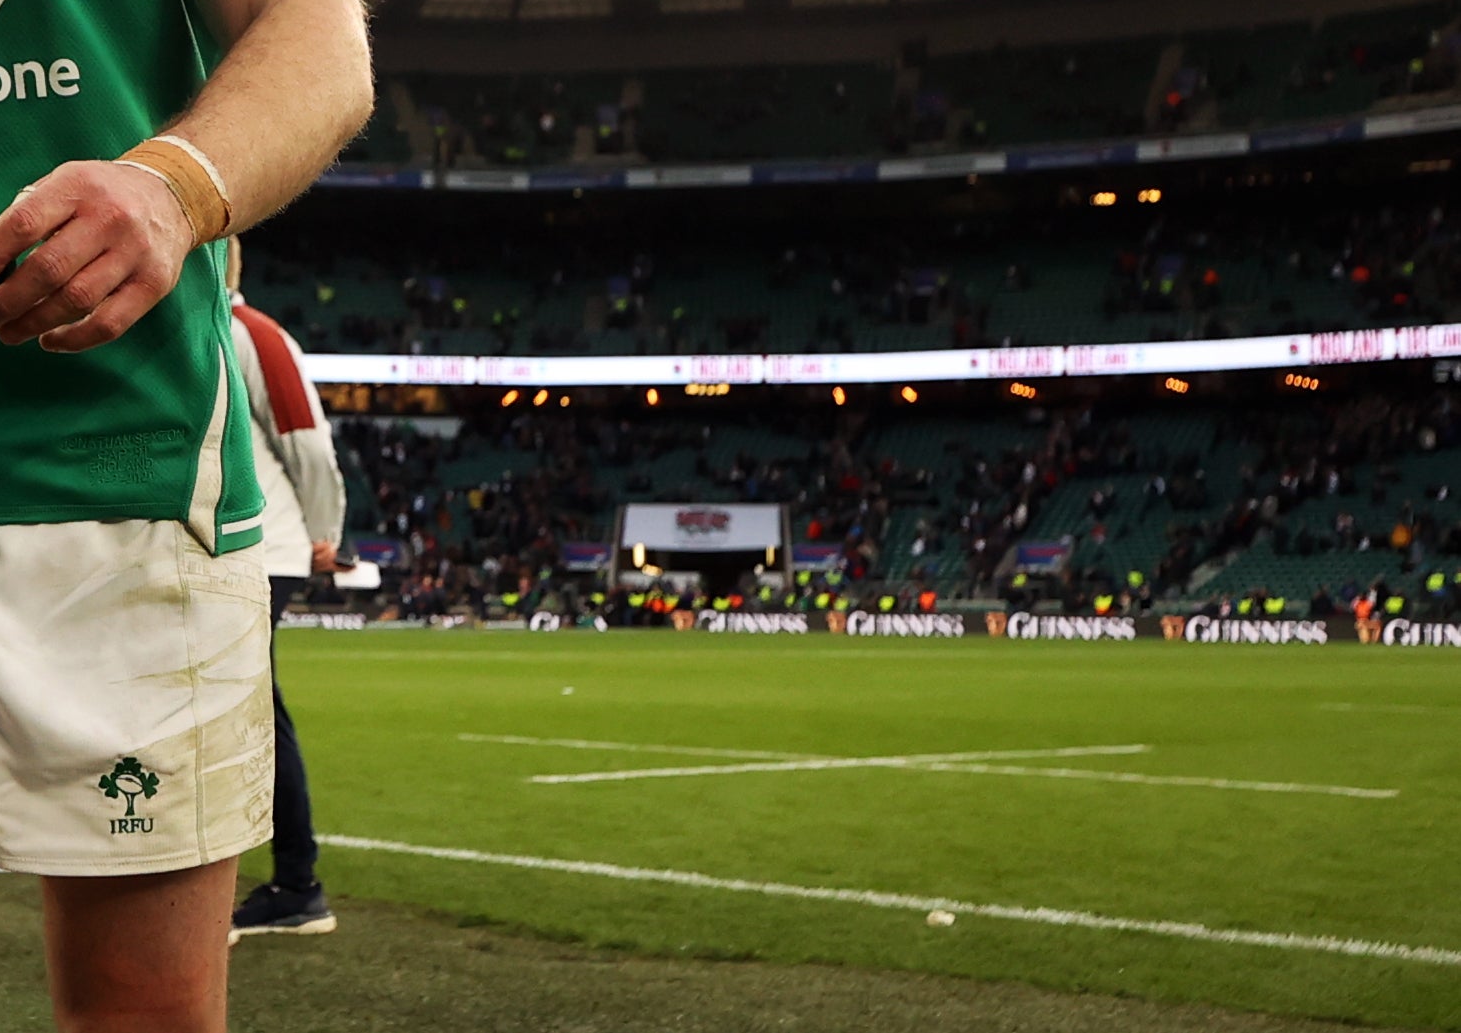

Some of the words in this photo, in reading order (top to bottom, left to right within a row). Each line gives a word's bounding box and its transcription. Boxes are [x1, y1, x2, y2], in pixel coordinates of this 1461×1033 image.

[846, 610, 965, 638] GUINNESS
[1007, 611, 1136, 641] GUINNESS
[1185, 614, 1328, 645] GUINNESS
[110, 818, 154, 835] IRFU
